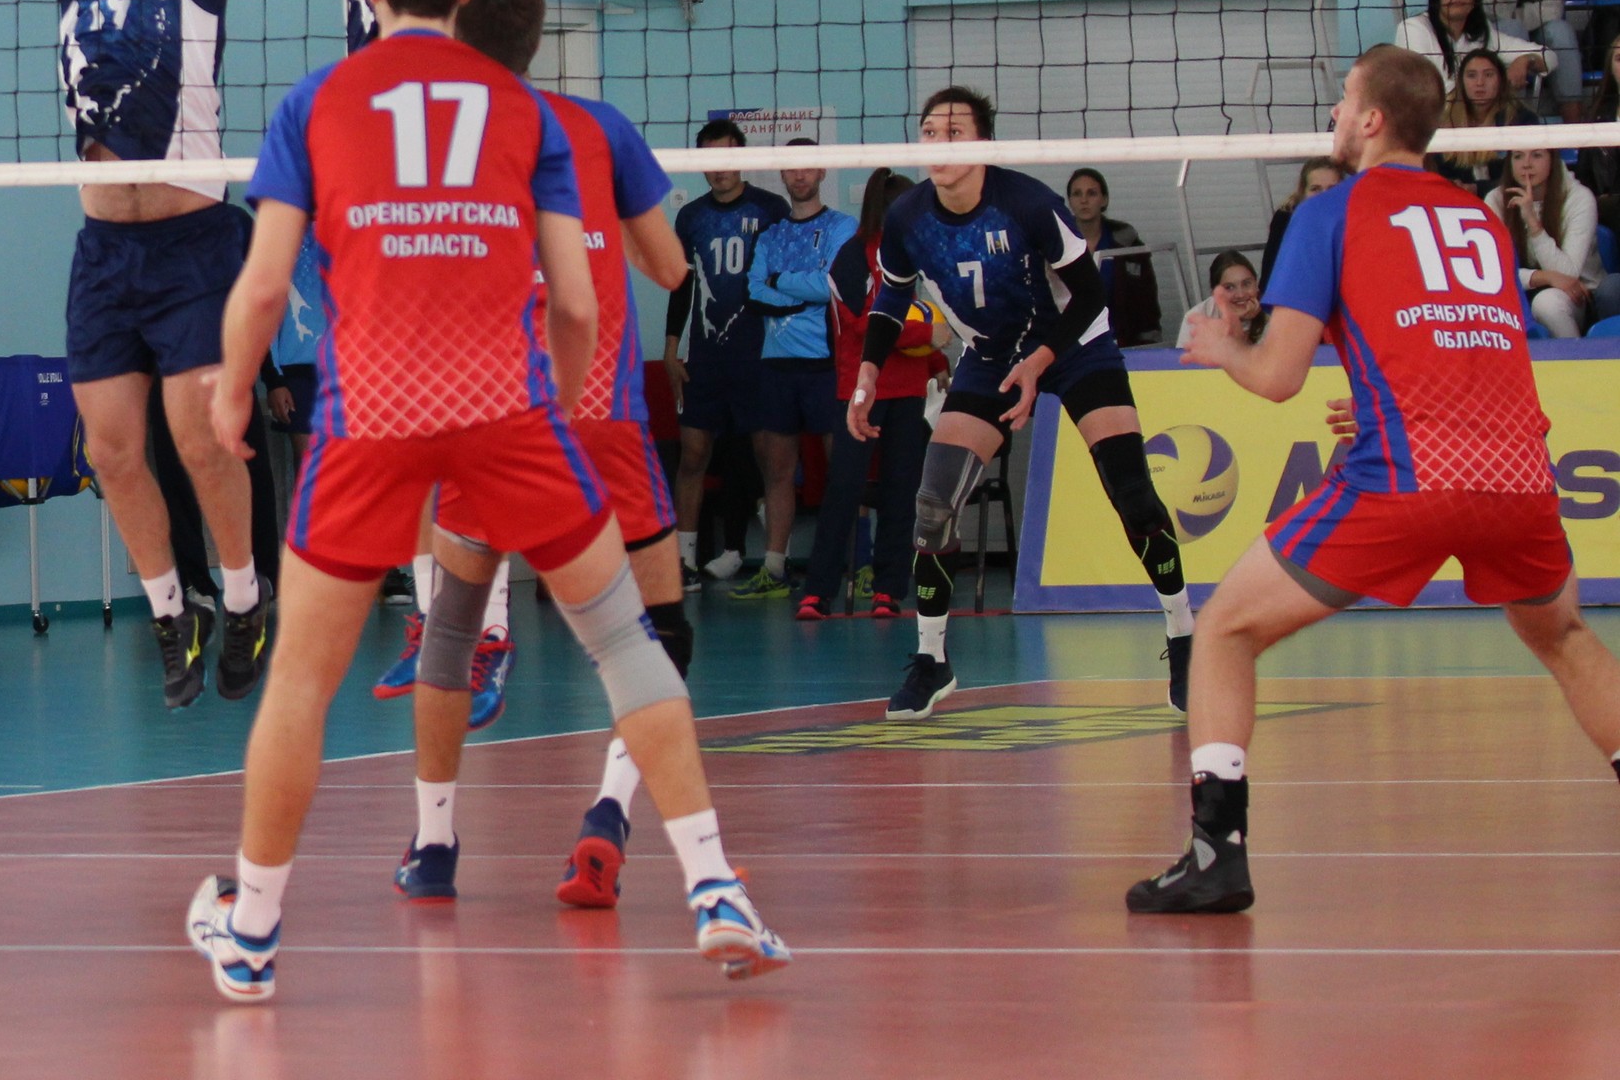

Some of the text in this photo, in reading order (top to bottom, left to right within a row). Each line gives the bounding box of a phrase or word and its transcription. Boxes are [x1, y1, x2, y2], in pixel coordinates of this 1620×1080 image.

[369, 81, 490, 188] 17
[743, 121, 803, 134] ЗАНЯТИЙ
[346, 201, 520, 228] ОРЕНБУРГСКАЯ
[382, 234, 489, 258] ОБЛАСТЬ
[709, 236, 745, 276] 10
[1389, 205, 1503, 295] 15
[957, 260, 986, 309] 7
[1395, 303, 1522, 332] ОРЕНБУРГСКАЯ
[1433, 329, 1512, 351] ОБЛАСТЬ
